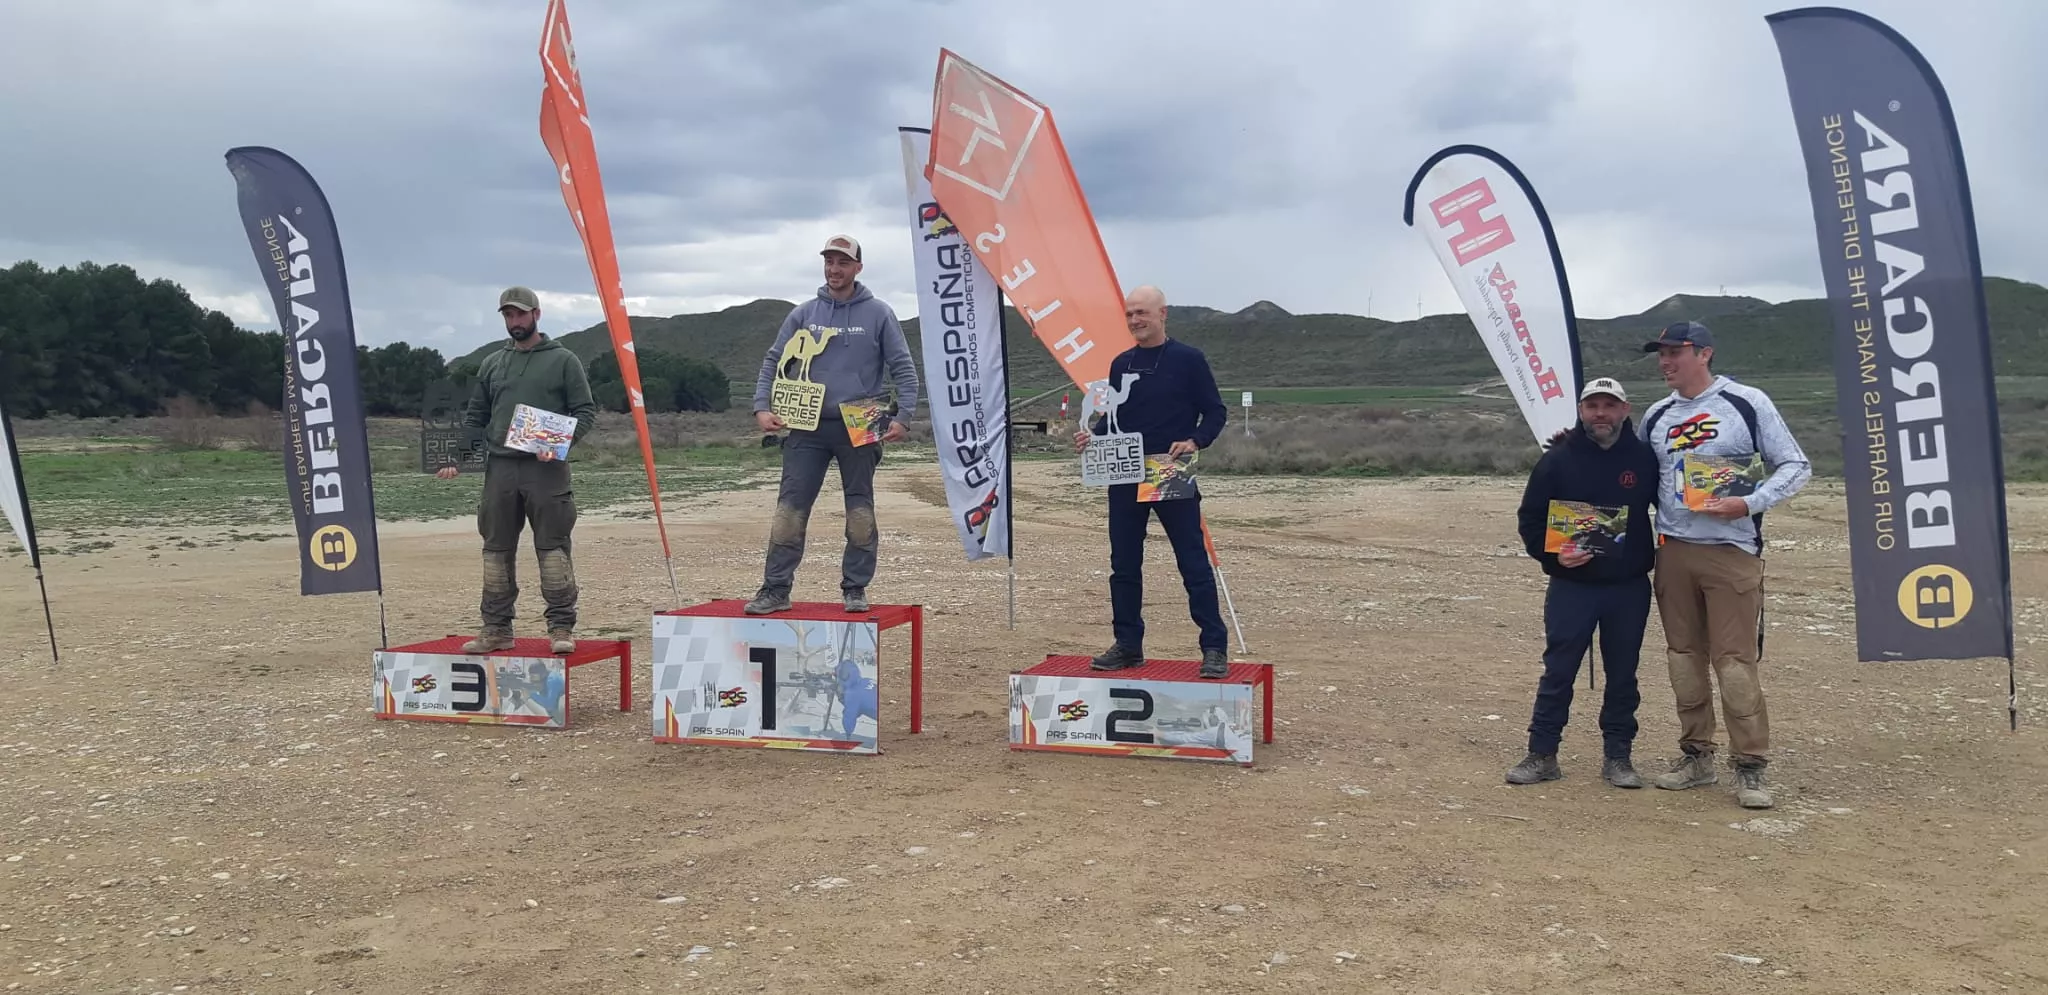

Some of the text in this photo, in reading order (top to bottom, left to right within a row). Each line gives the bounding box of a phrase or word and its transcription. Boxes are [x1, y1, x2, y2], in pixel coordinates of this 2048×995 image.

[961, 242, 977, 330] COMPETICIÓN
[932, 243, 972, 407] ESPAÑA
[968, 333, 980, 379] SOMOS
[775, 382, 823, 395] PRECISION
[773, 391, 820, 408] RIFLE
[772, 405, 817, 420] SERIES
[1665, 418, 1721, 444] PRS
[952, 418, 990, 489] PRS
[1085, 446, 1140, 463] RIFLE
[1086, 460, 1141, 475] SERIES
[1110, 472, 1142, 480] ESPAÑA
[451, 662, 486, 712] 3
[749, 647, 777, 731] 1
[403, 701, 448, 711] PRS SPAIN
[1106, 687, 1154, 744] 2
[693, 726, 745, 737] PRS SPAIN
[1046, 730, 1102, 741] PRS SPAIN
